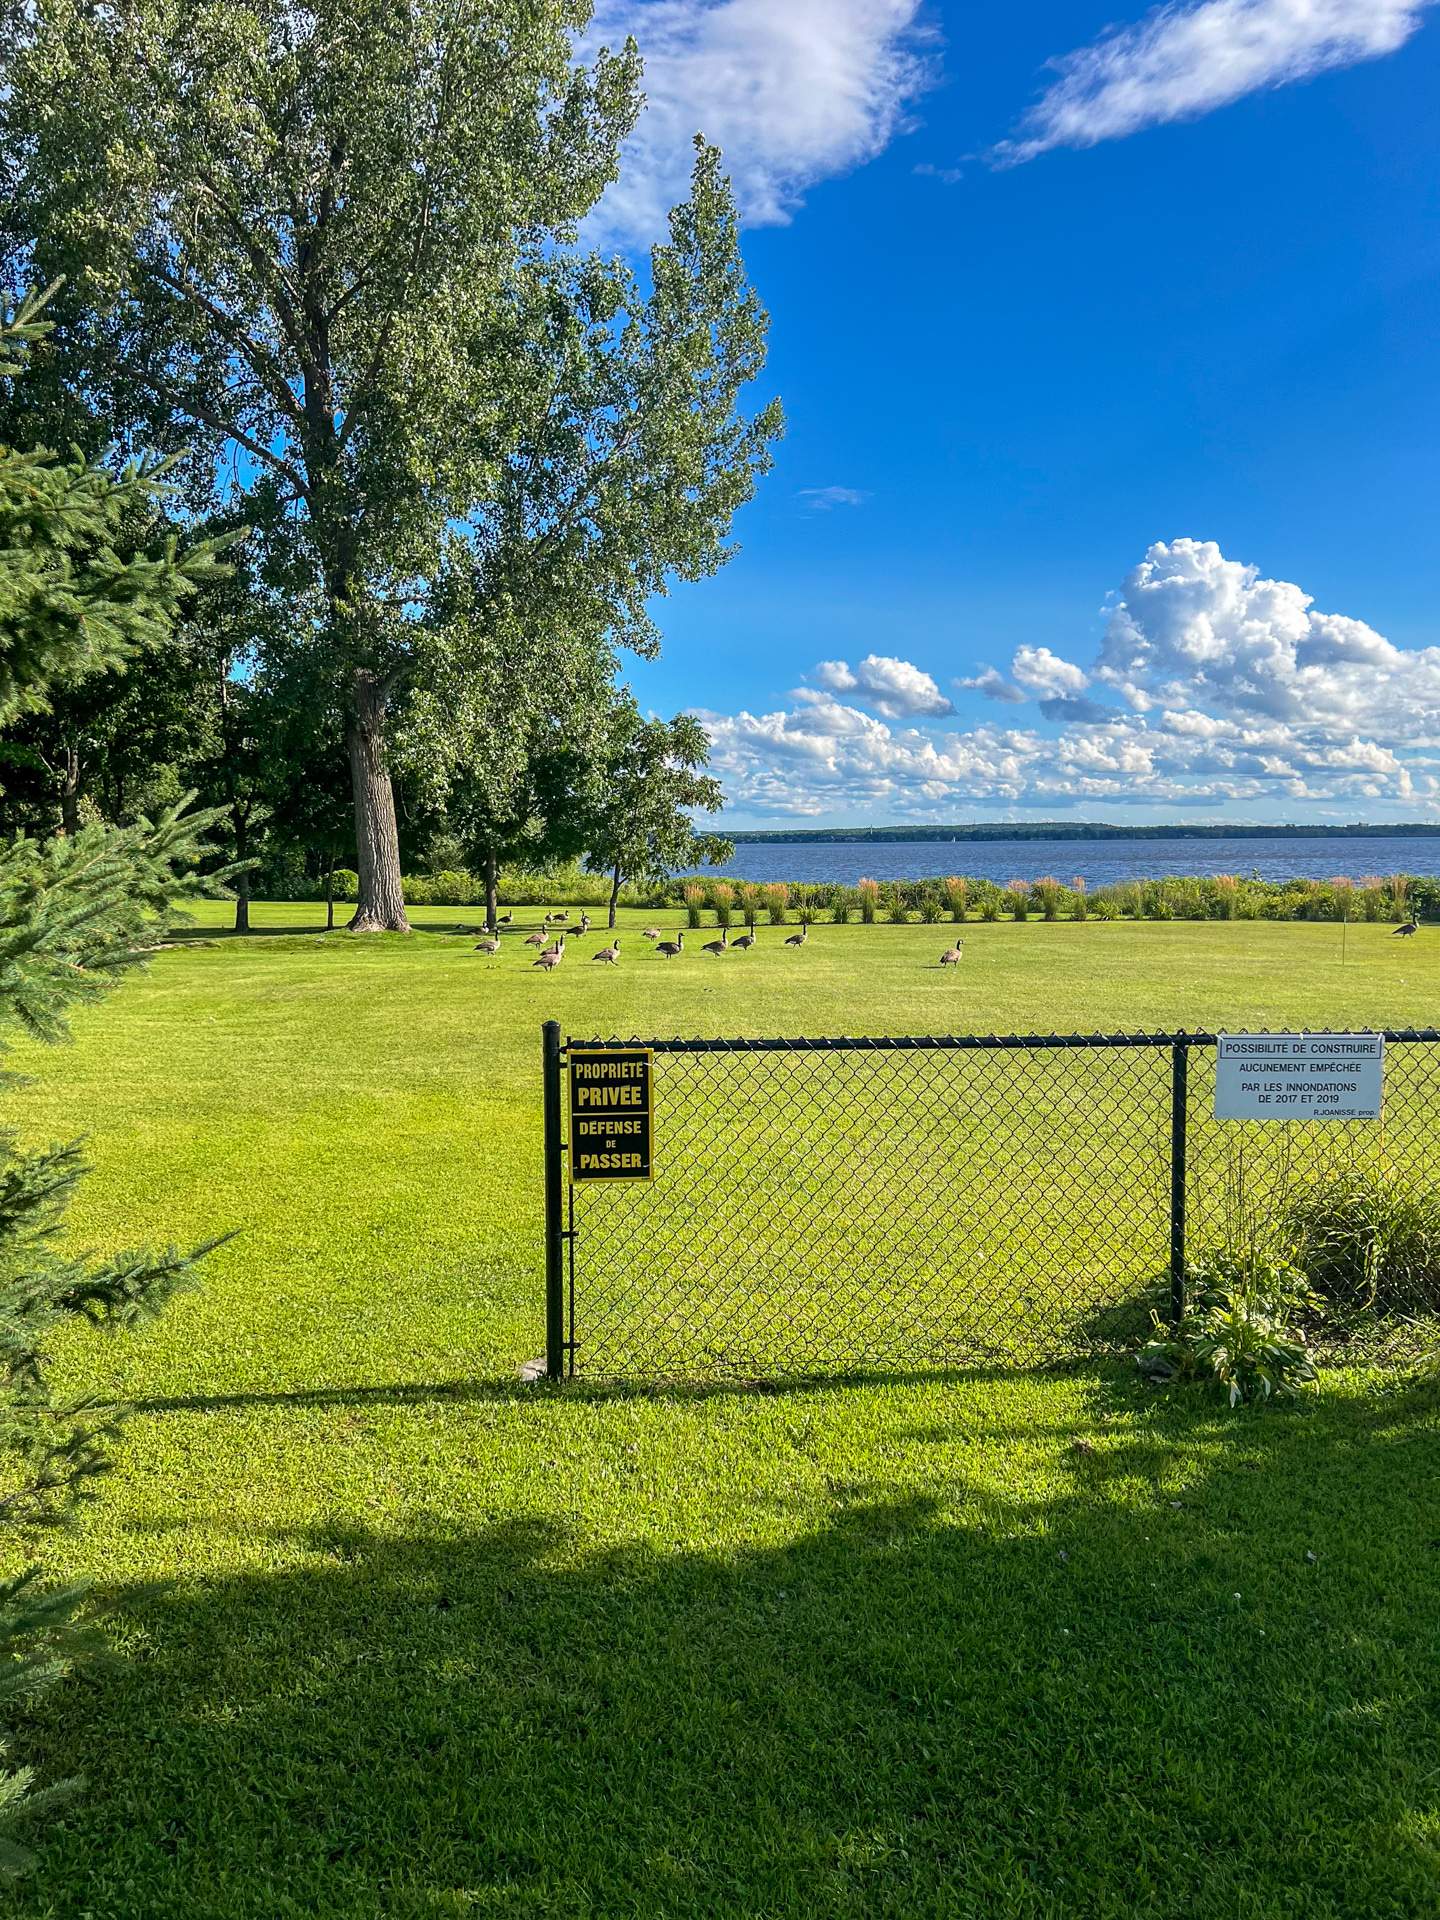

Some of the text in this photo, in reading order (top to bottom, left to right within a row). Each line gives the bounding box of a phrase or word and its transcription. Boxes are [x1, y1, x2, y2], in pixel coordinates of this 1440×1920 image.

[1226, 1041, 1376, 1053] POSSIBILITÉ DE CONSTRUIRE
[576, 1061, 644, 1079] PROPRIÉTÉ
[1239, 1063, 1306, 1073] AUCUNEMENT
[1242, 1083, 1357, 1092] PAR LES INNONDATIONS
[578, 1085, 642, 1106] PRIVÉE
[1258, 1095, 1340, 1104] DE 2017 ET 2019
[579, 1120, 642, 1135] DÉFENSE
[606, 1140, 617, 1149] DE
[580, 1153, 642, 1169] PASSER
